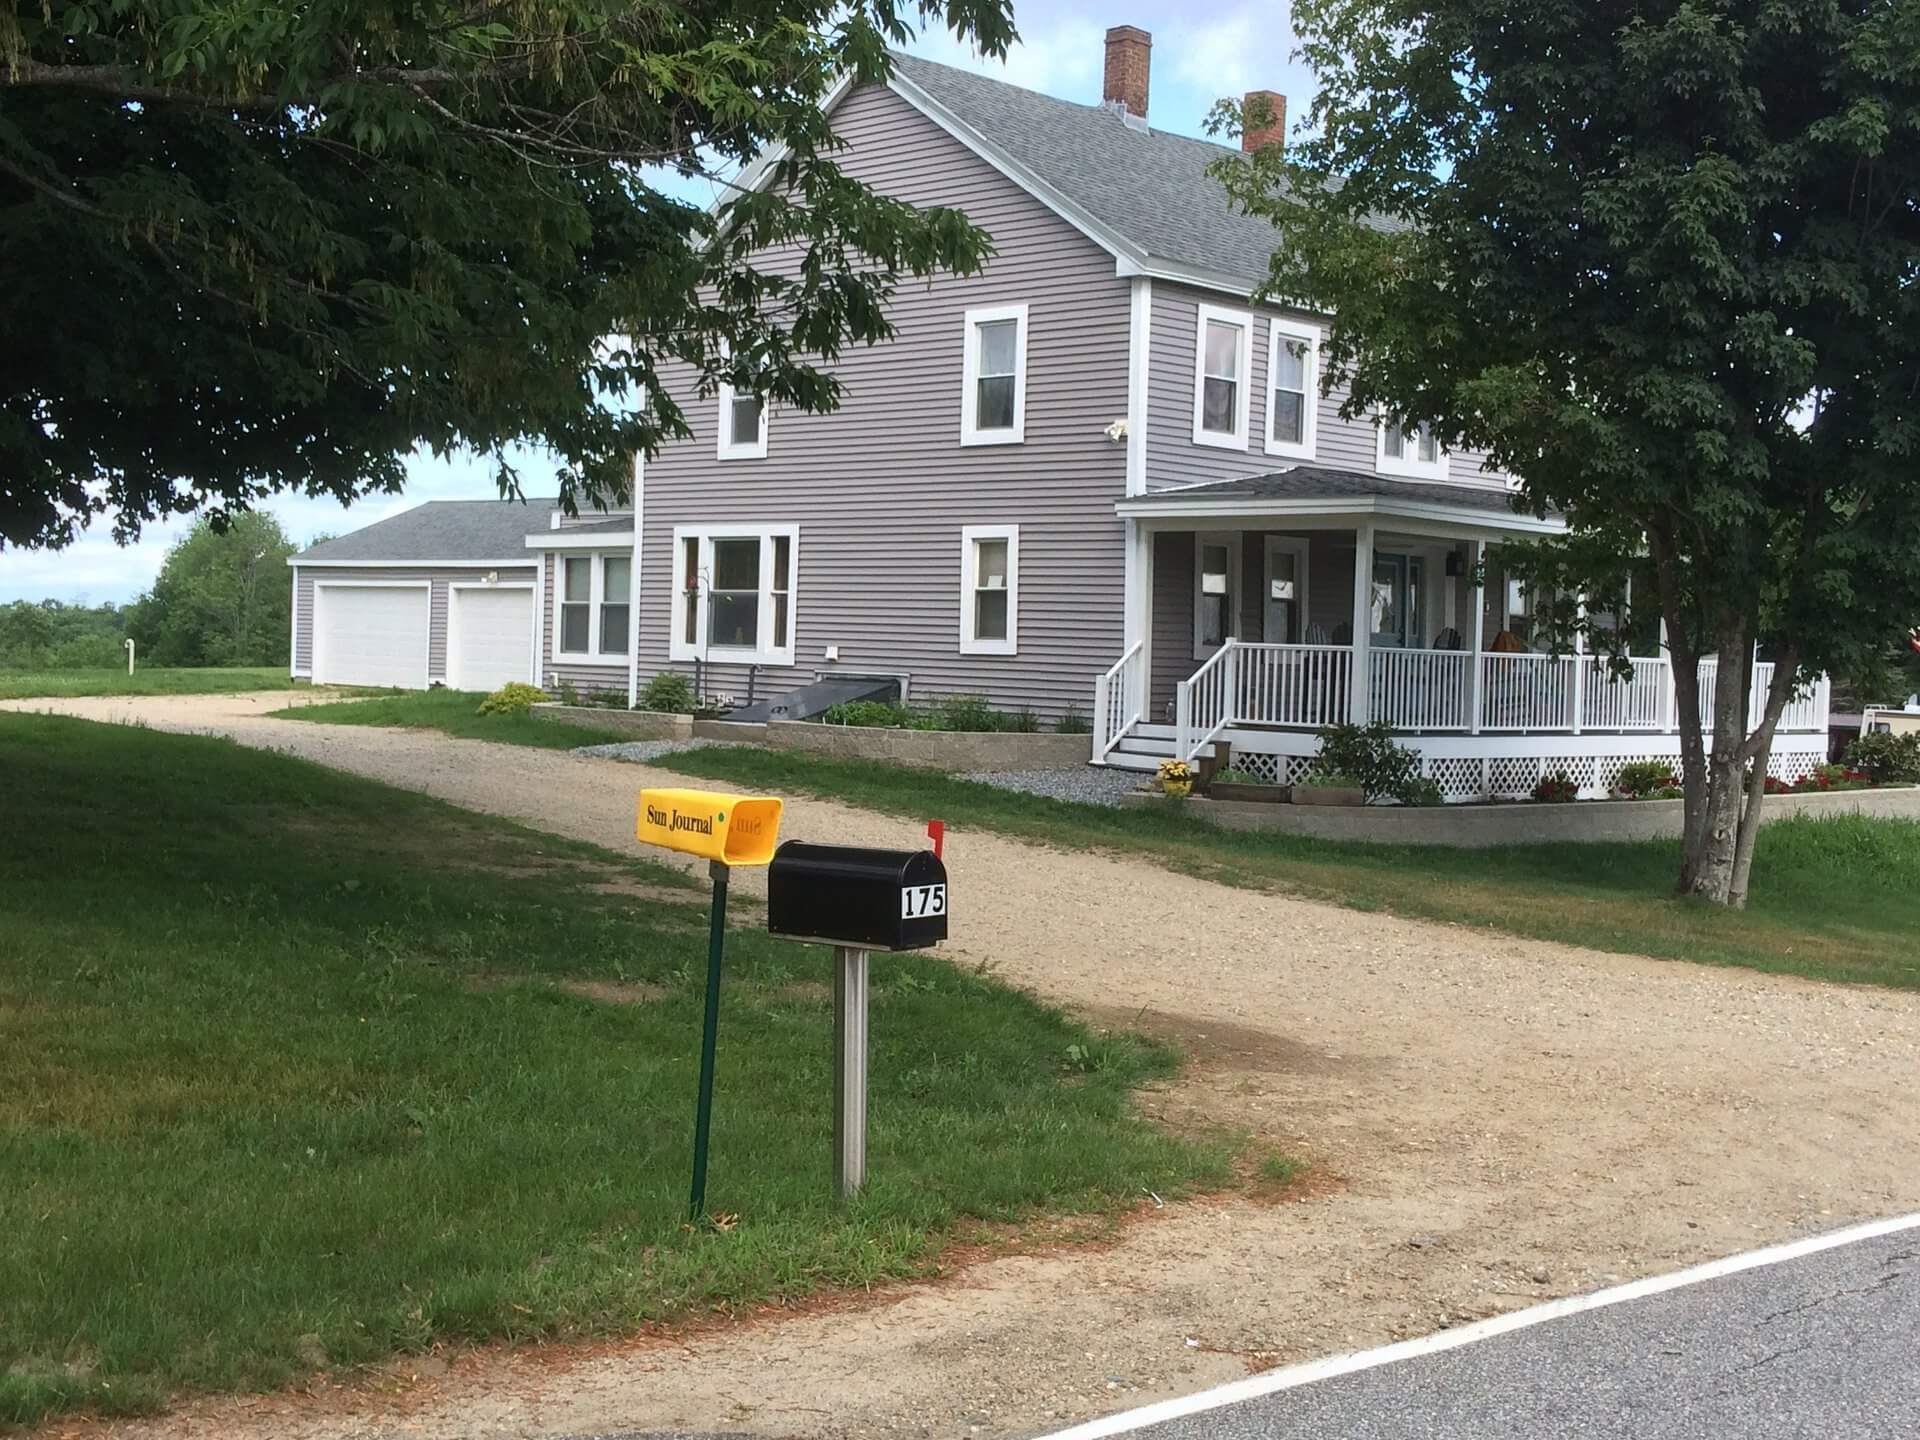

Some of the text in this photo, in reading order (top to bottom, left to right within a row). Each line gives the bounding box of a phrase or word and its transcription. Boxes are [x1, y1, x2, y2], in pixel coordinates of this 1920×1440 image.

[647, 804, 713, 835] Sun Journal
[905, 886, 944, 917] 175
